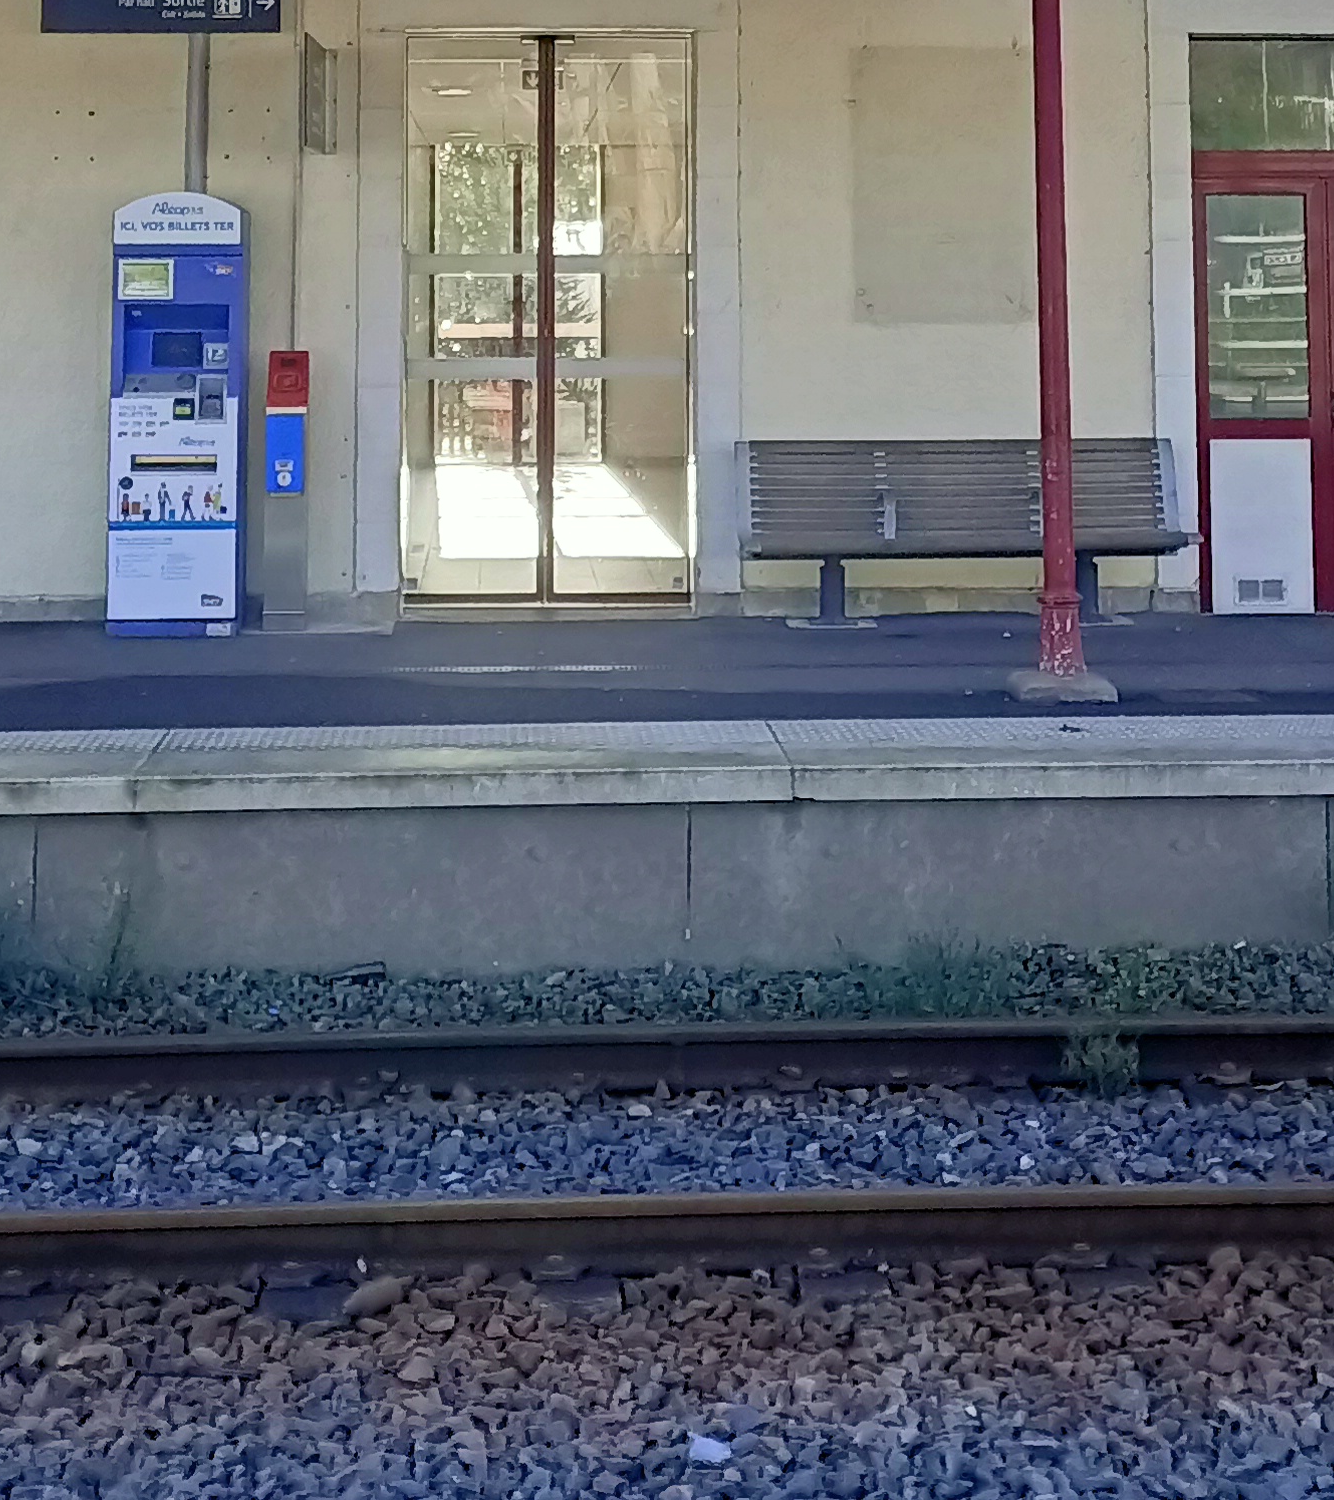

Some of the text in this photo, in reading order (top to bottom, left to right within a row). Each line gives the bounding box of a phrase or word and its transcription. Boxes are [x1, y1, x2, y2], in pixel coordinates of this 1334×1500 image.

[141, 220, 165, 232] VOS
[167, 221, 210, 232] BILLETS
[213, 221, 234, 232] TER
